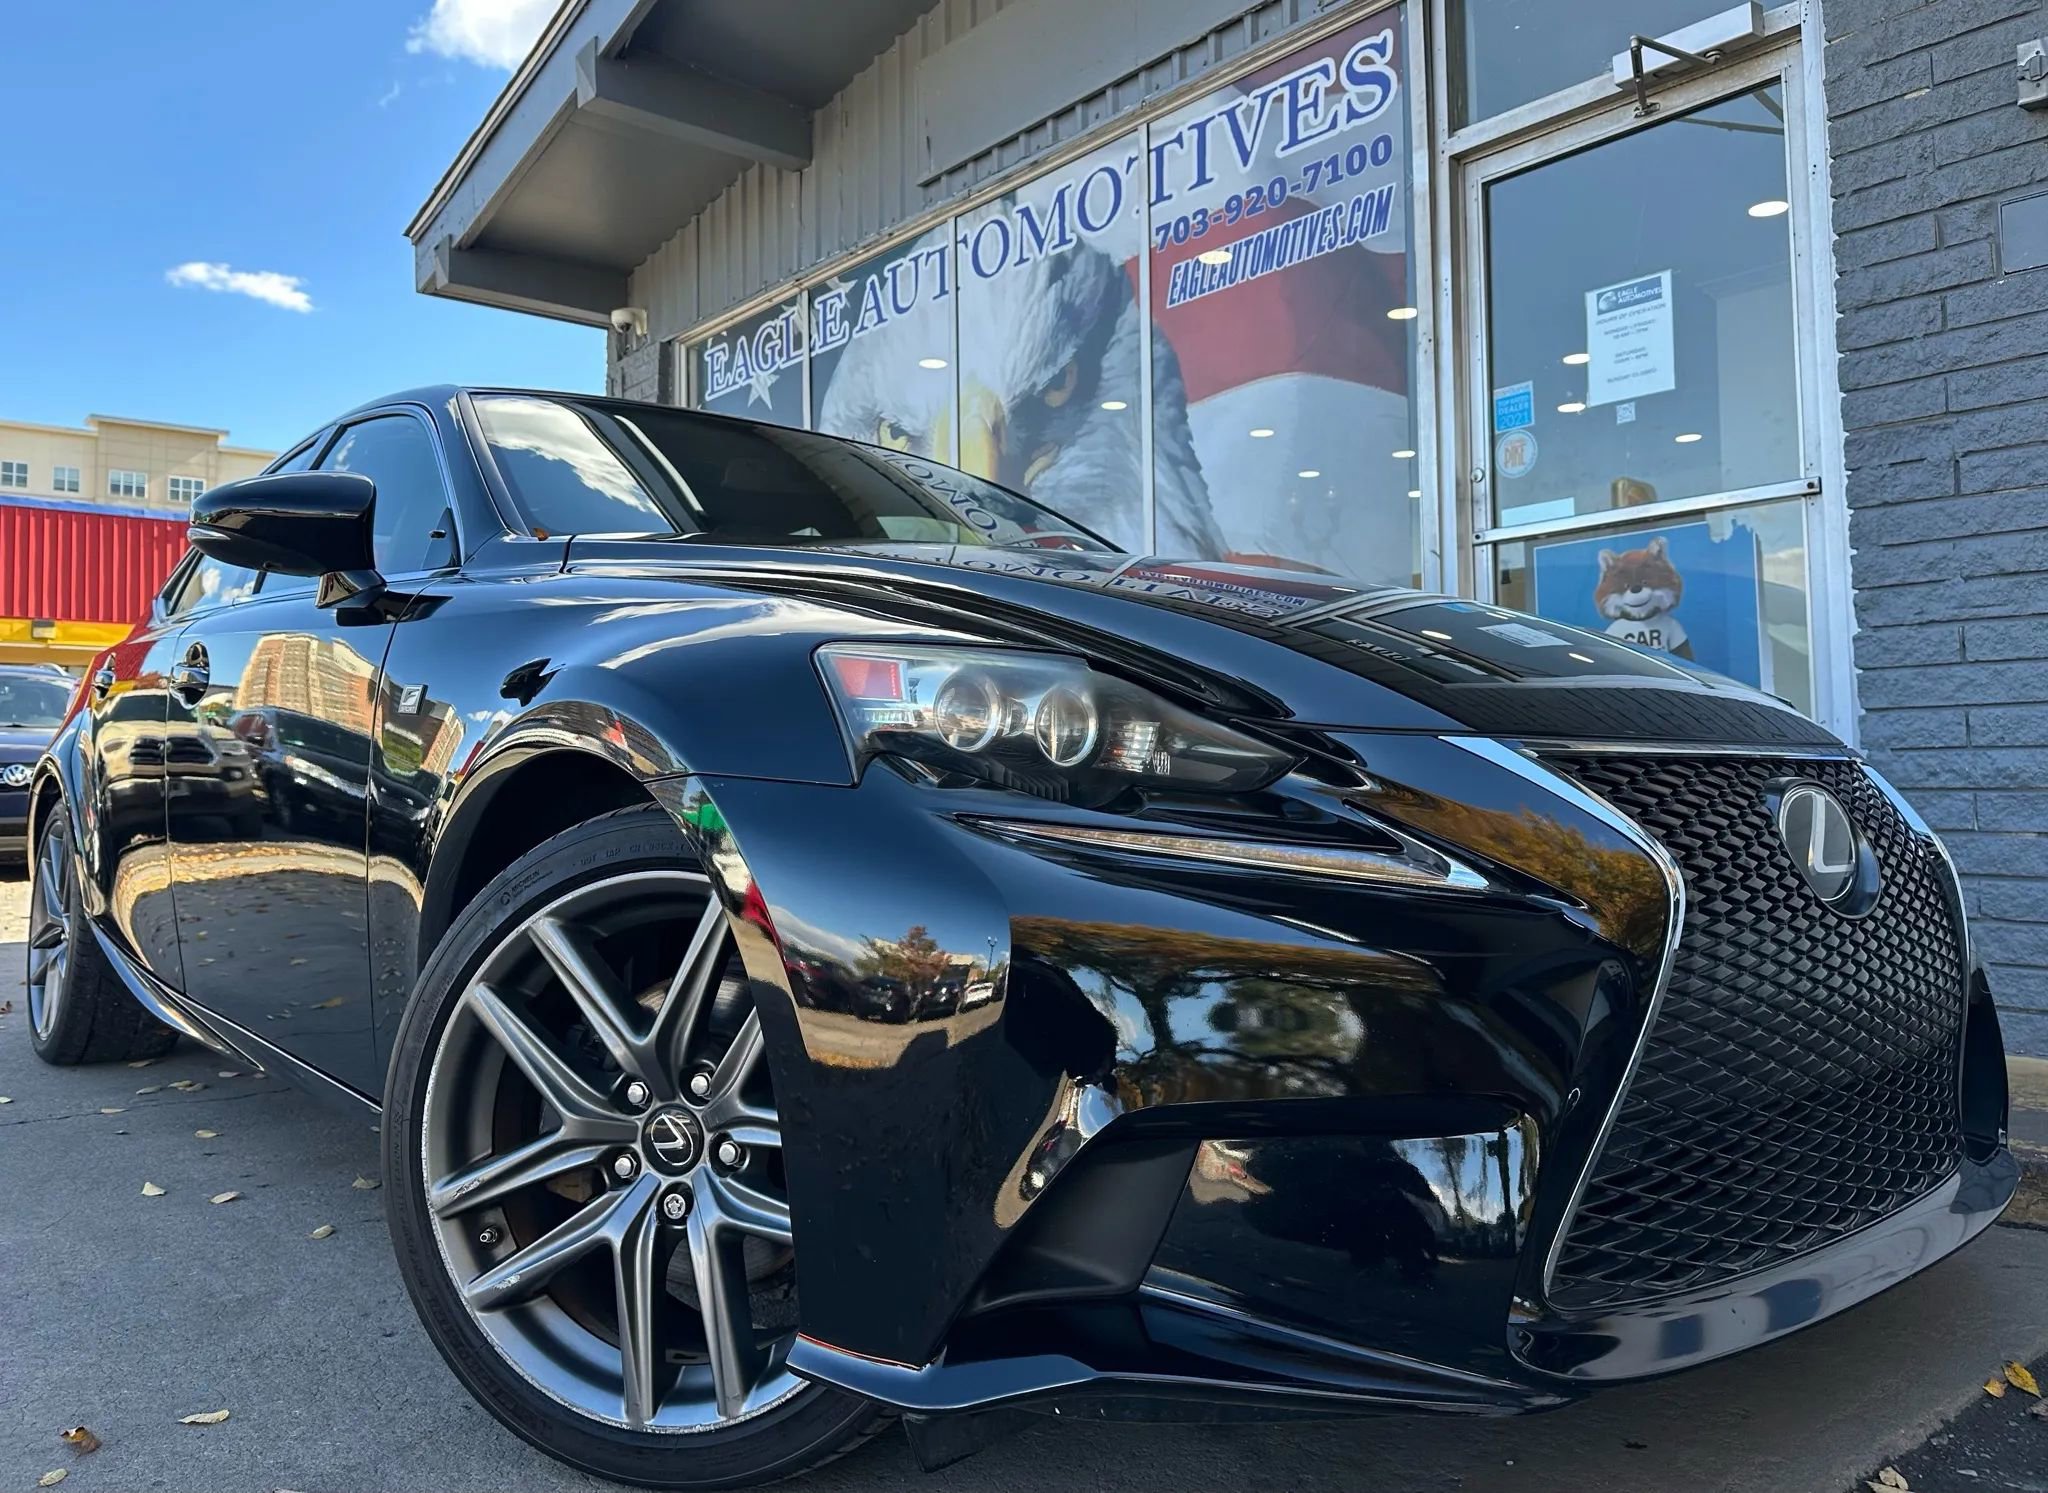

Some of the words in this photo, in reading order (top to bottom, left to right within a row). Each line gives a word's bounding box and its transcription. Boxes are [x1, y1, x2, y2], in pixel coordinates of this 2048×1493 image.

[704, 290, 848, 399] EAGLE
[855, 32, 1394, 332] AUTOMOTIVES
[1155, 134, 1394, 251] 703-920-7100
[1167, 184, 1396, 309] EAGLEAUTOMOTIVES.COM
